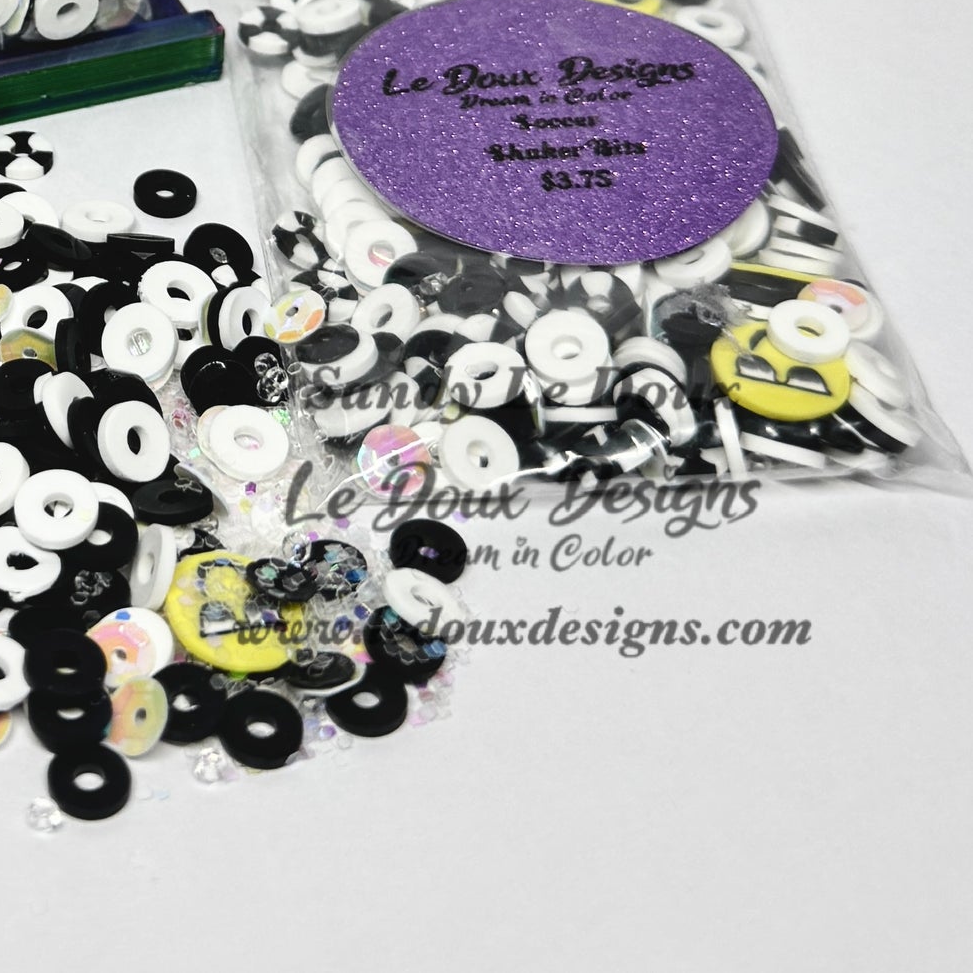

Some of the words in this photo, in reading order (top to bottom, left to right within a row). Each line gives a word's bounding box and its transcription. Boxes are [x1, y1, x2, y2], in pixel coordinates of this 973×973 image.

[382, 68, 434, 95] Le
[442, 63, 542, 95] Doux
[558, 56, 695, 88] Designs
[460, 93, 532, 109] Dream
[539, 91, 557, 104] in
[563, 88, 632, 105] Color
[511, 114, 599, 130] Soccer
[484, 141, 581, 162] Shaker
[585, 138, 648, 156] Bits
[541, 169, 613, 192] $3.75
